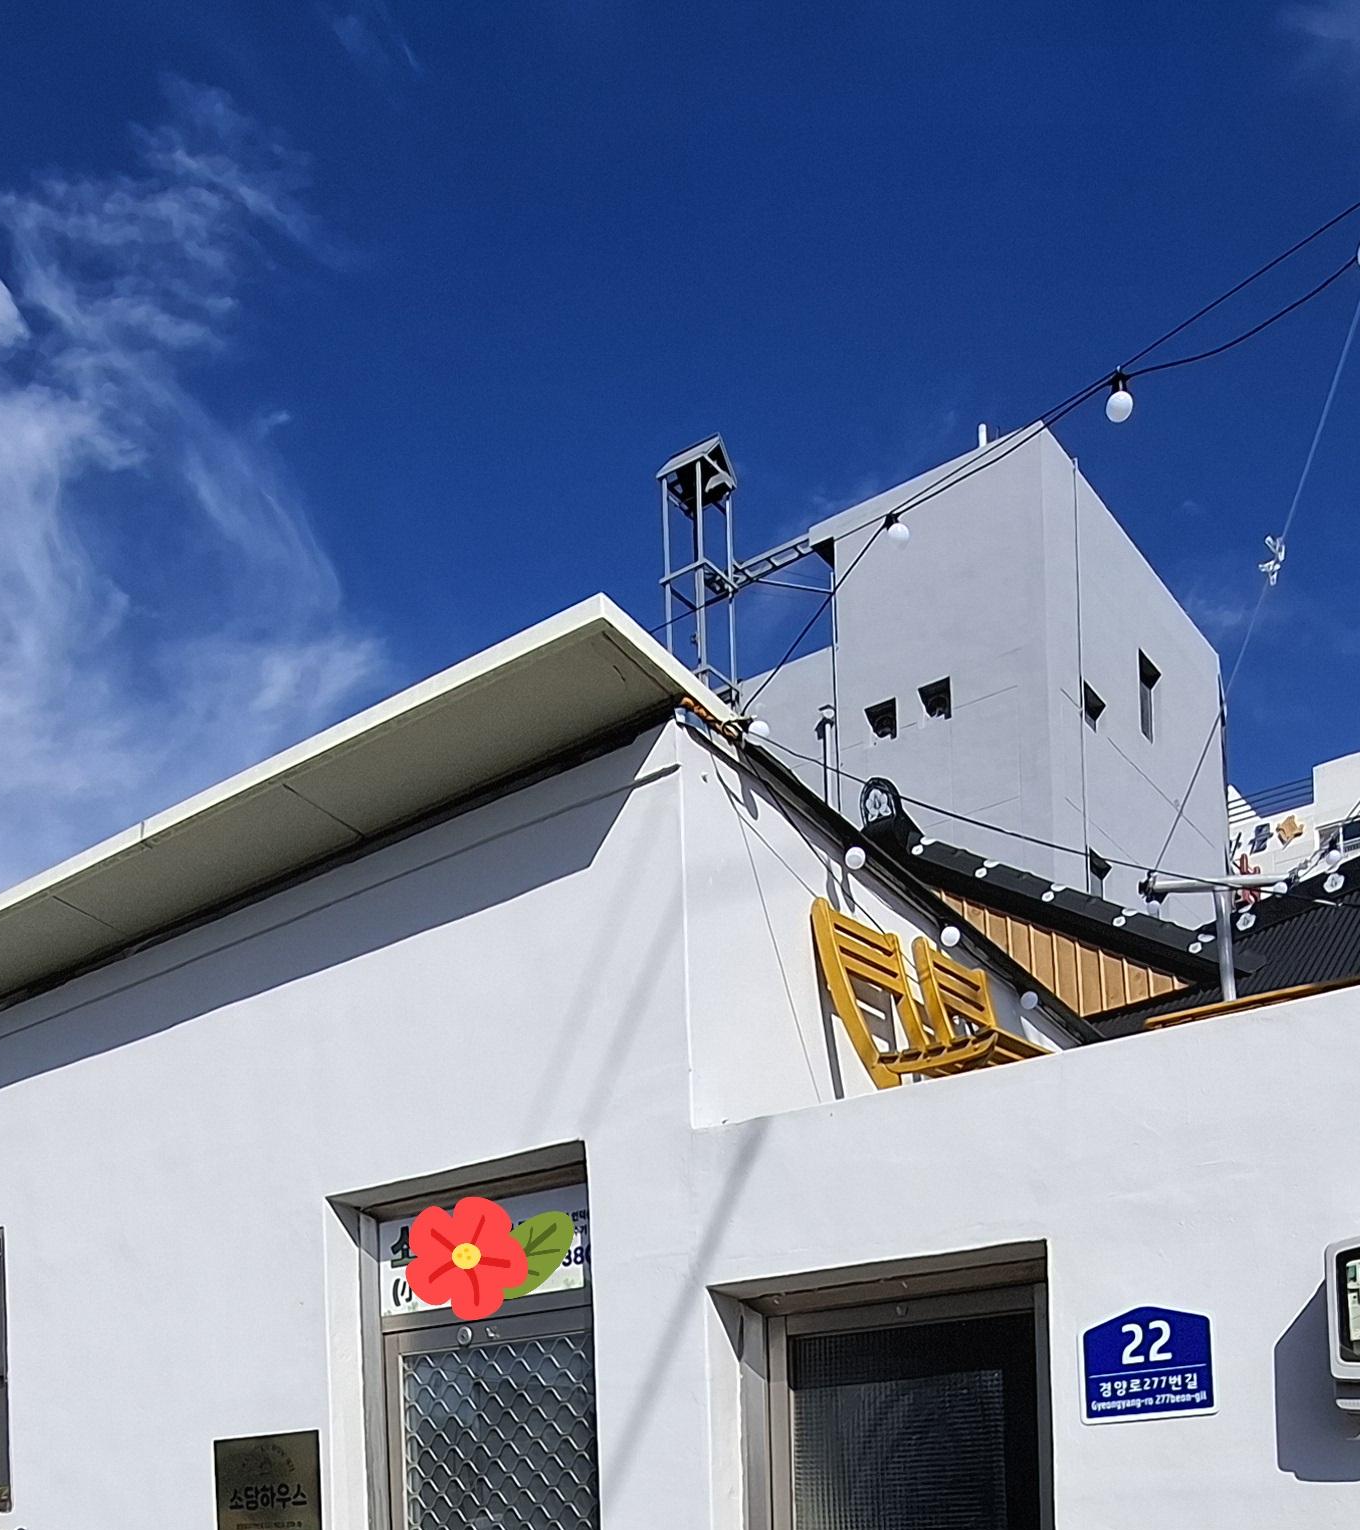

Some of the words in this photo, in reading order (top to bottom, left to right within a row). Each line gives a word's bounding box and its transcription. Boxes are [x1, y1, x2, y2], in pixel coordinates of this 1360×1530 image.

[1121, 1319, 1173, 1365] 22
[1099, 1372, 1199, 1398] 경양로277번길
[1091, 1397, 1154, 1412] Gyeongyang-ro
[1155, 1390, 1208, 1405] 277beon-gil
[229, 1484, 308, 1511] 소담하우스
